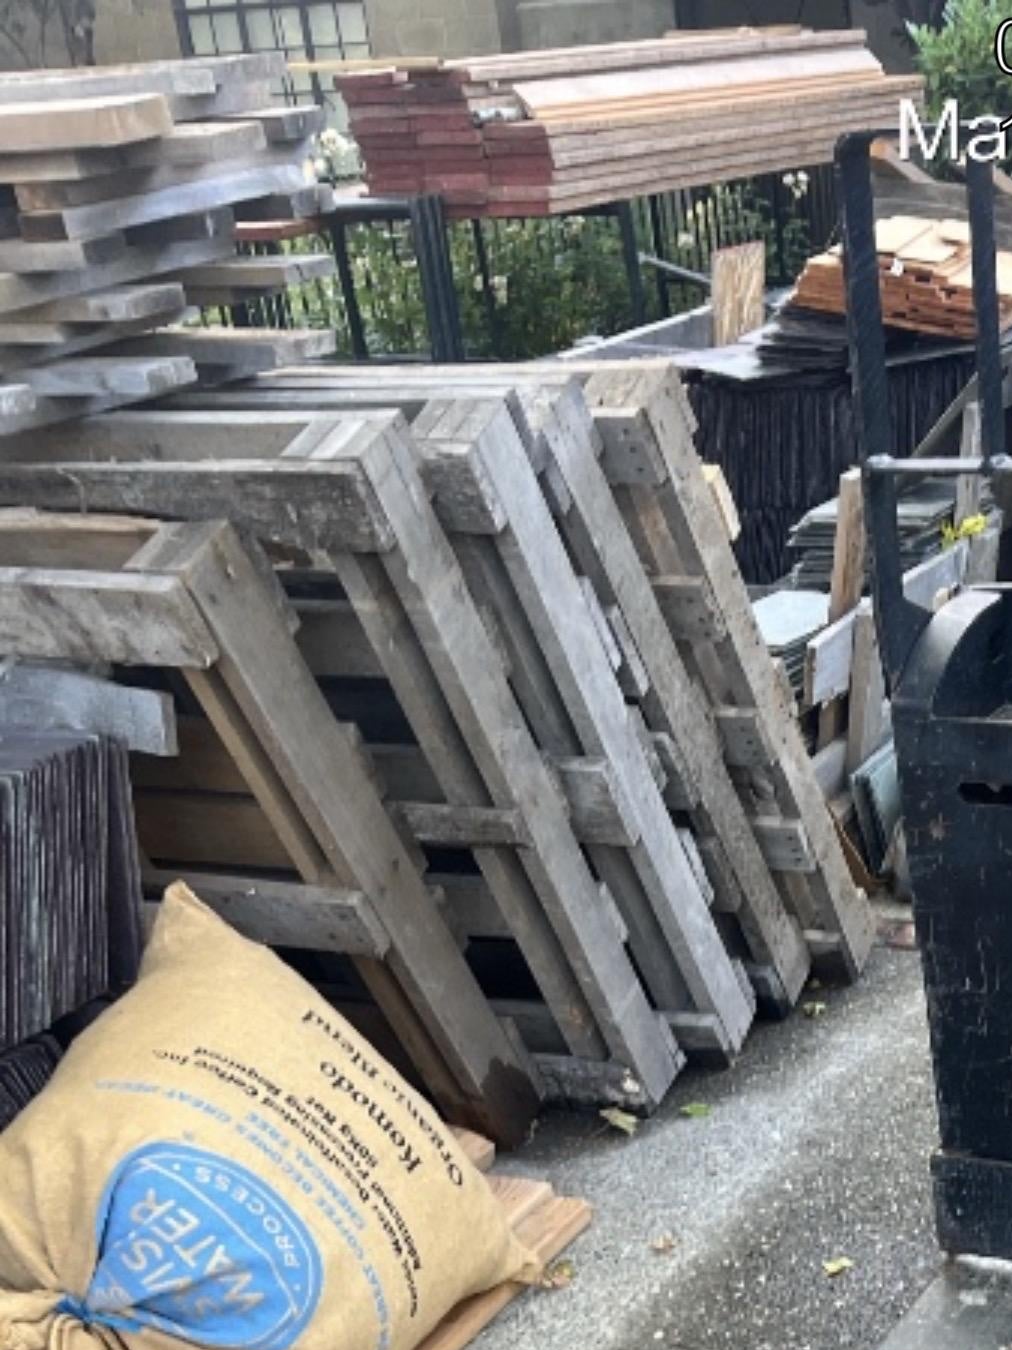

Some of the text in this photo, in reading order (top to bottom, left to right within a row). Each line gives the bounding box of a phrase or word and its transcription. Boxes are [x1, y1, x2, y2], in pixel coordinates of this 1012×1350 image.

[301, 1008, 464, 1188] Organic Blend
[319, 1060, 423, 1174] Komodo
[130, 1187, 265, 1309] WATER
[194, 1165, 300, 1268] PROCESS
